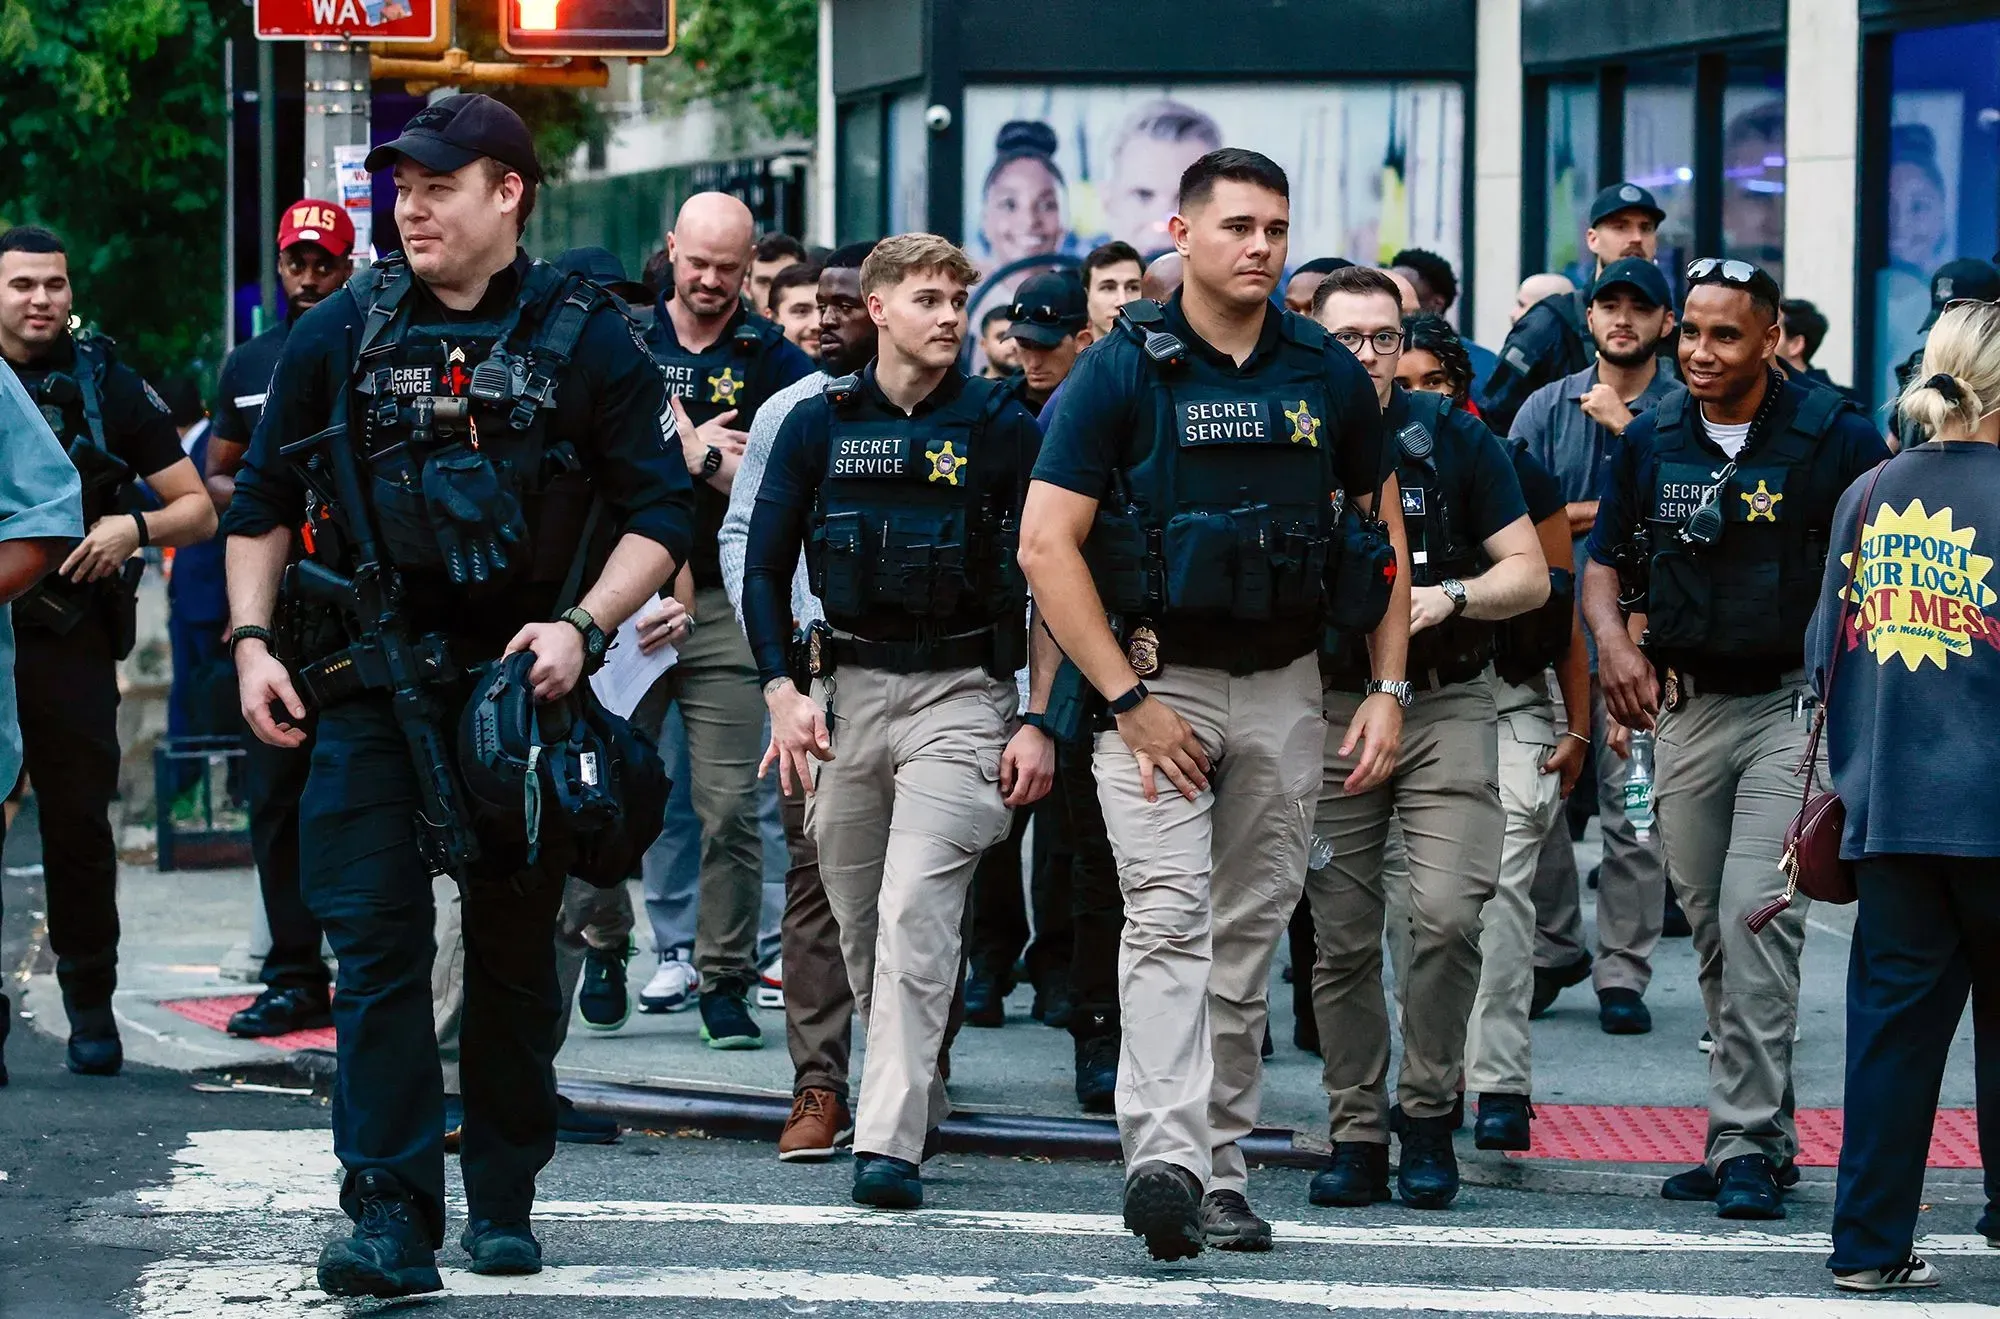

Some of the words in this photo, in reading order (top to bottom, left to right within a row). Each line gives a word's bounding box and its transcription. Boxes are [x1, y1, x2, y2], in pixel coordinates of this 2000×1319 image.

[312, 0, 371, 26] WA
[292, 206, 336, 231] WAS
[394, 367, 431, 381] CRET
[660, 365, 694, 381] RET
[393, 381, 431, 395] RVICE
[664, 382, 695, 398] VICE
[1187, 402, 1258, 421] SECRET
[1185, 421, 1265, 442] SERVICE
[840, 439, 902, 455] SECRET
[834, 458, 904, 474] SERVICE
[1660, 502, 1697, 518] SERV
[1861, 533, 1973, 573] SUPPORT
[1887, 624, 1897, 633] a
[1900, 624, 1937, 640] messy
